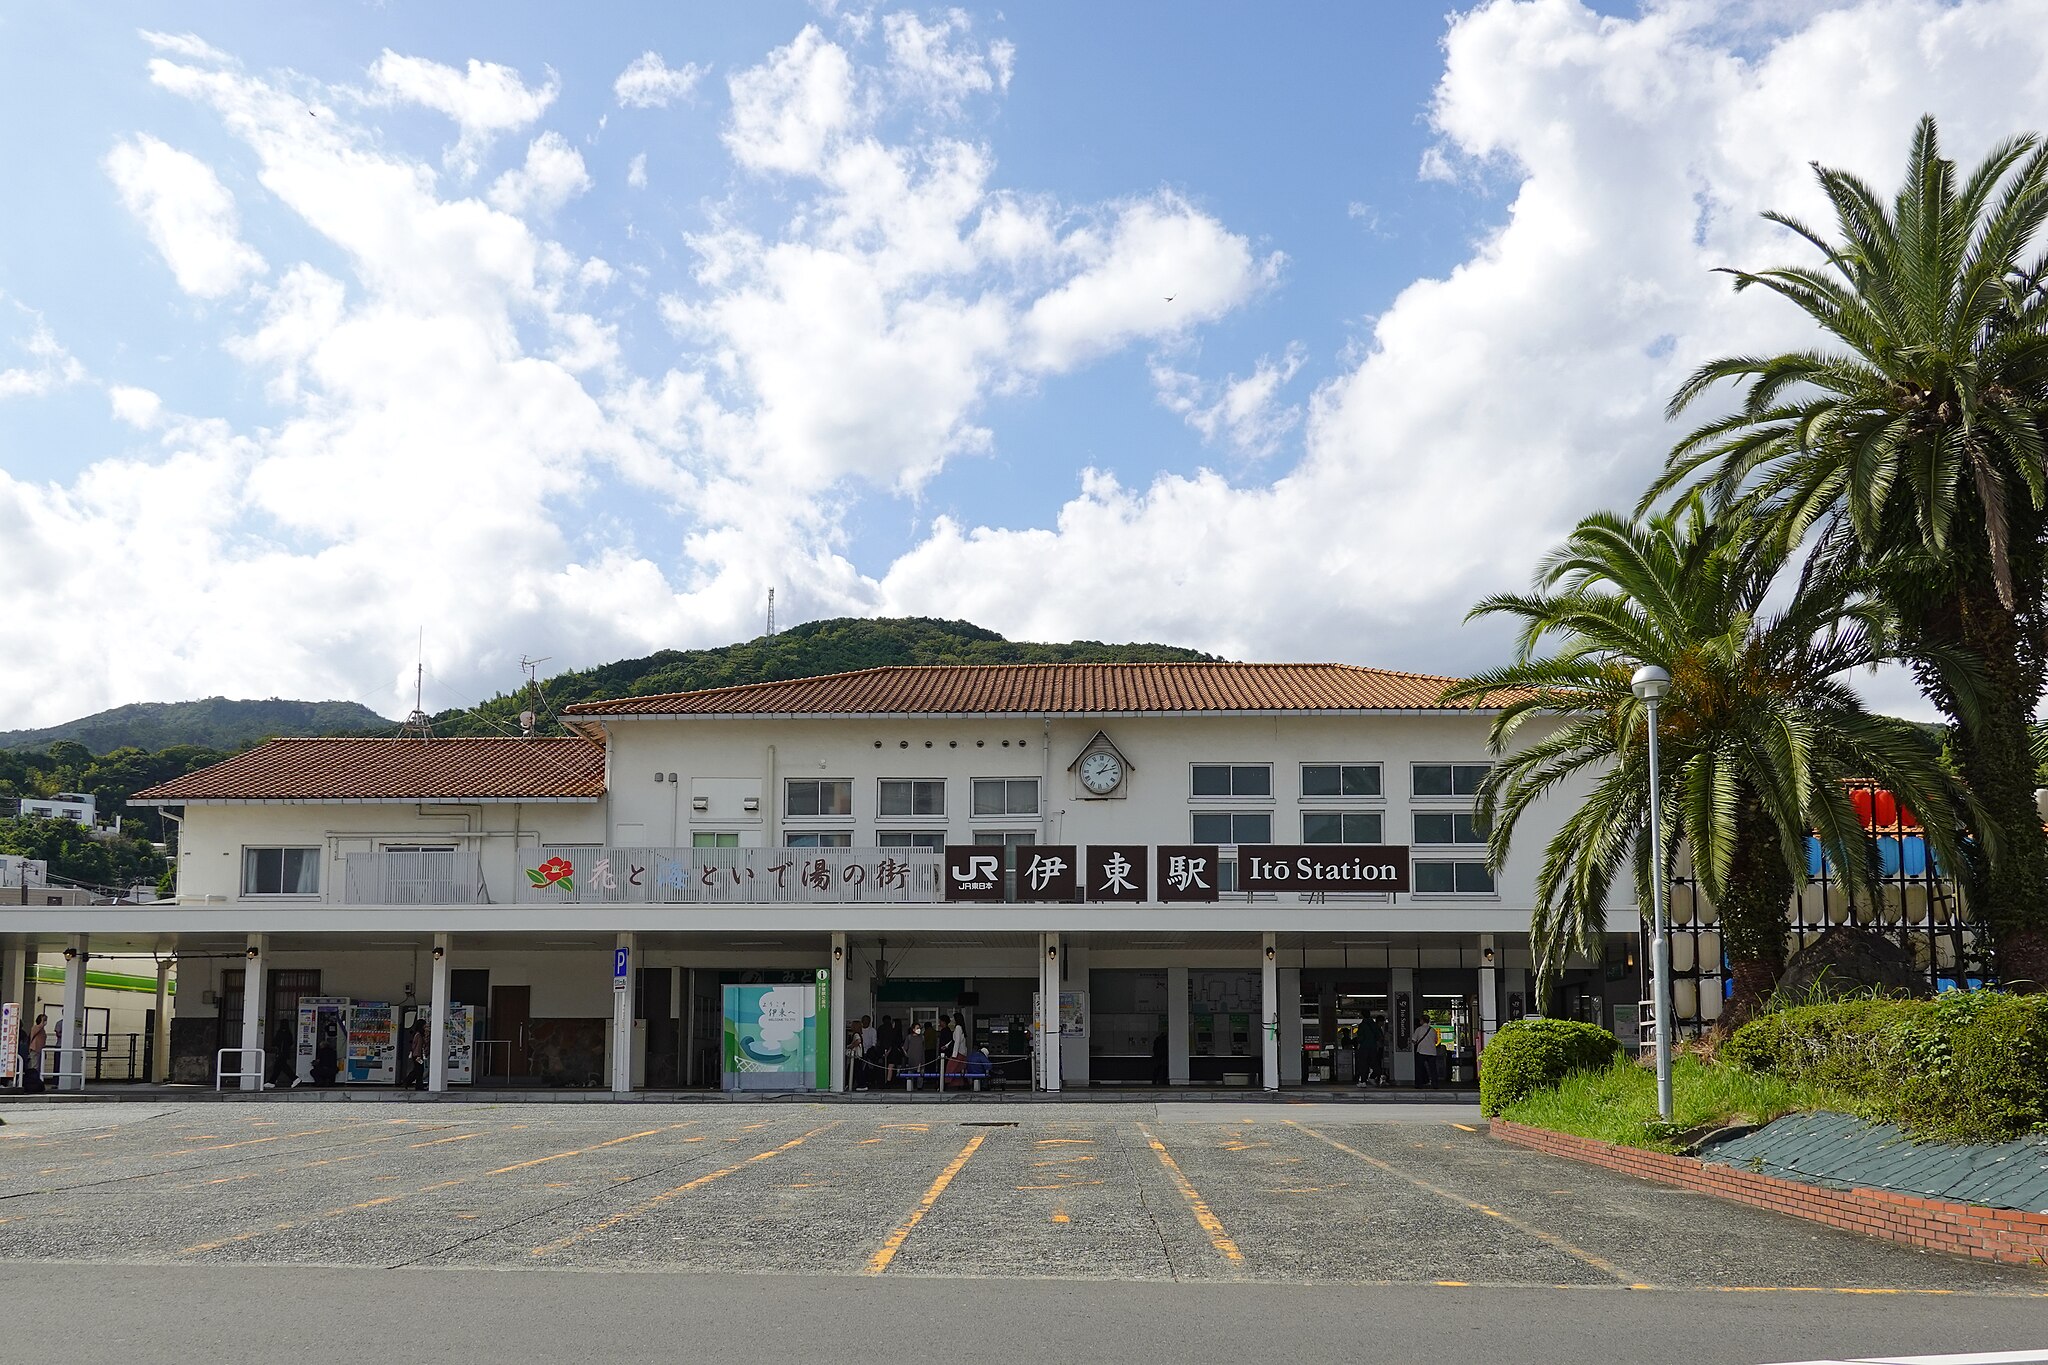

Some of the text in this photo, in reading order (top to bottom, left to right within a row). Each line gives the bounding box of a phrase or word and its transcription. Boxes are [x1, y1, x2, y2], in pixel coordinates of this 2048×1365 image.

[588, 857, 911, 893] 花と海といで湯の街
[952, 855, 999, 881] JR
[1025, 852, 1211, 895] 伊東駅
[1297, 857, 1398, 880] Station
[958, 881, 993, 891] JR東日本
[617, 951, 625, 974] P
